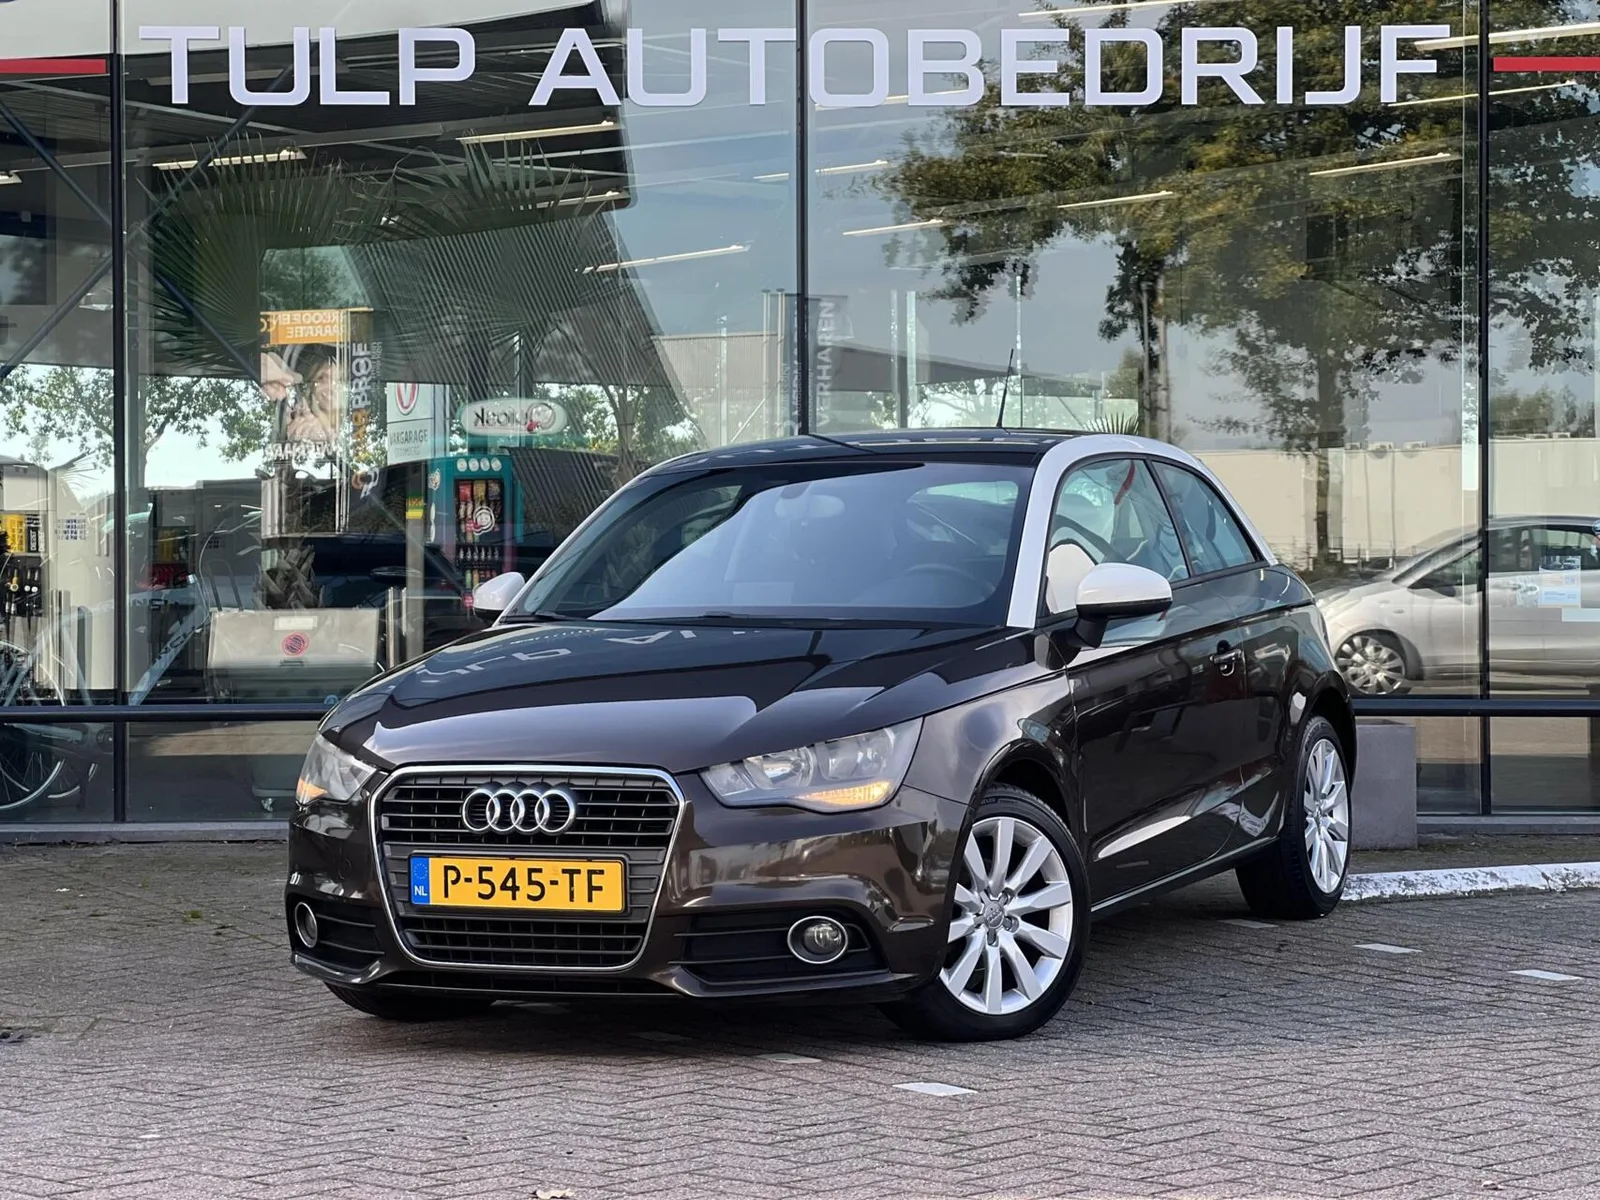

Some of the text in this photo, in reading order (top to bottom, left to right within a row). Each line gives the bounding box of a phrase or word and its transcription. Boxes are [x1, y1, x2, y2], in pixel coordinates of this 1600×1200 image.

[139, 25, 1450, 107] TULP AUTOBEDRIJF
[815, 301, 834, 427] VERHAREN
[389, 429, 428, 446] VAKGARAGE
[414, 865, 605, 903] NL P-545-TF
